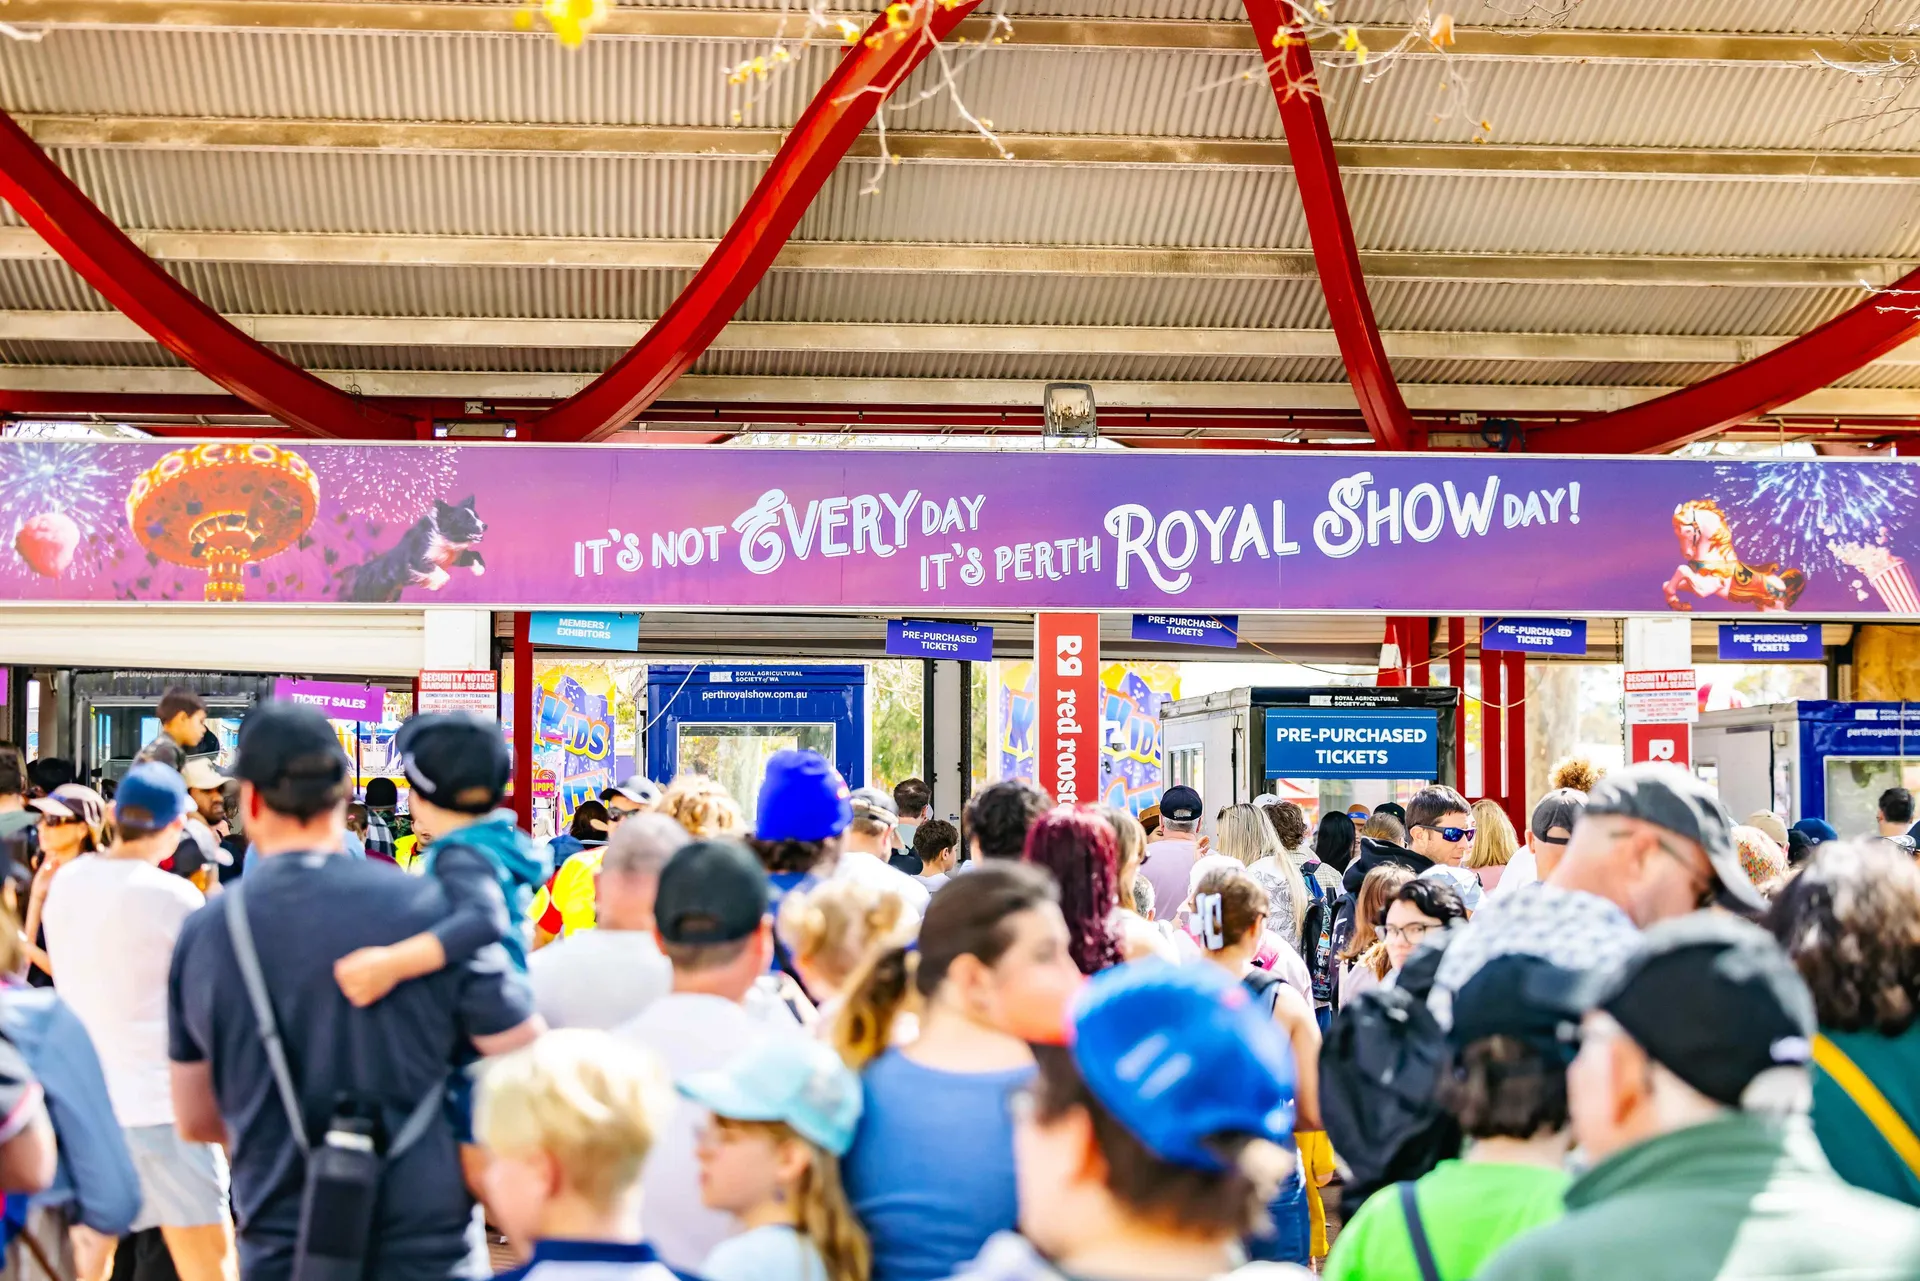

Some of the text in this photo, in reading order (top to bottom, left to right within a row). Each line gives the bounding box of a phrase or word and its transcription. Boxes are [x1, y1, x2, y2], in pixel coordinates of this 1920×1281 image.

[574, 488, 987, 578] IT'S NOT EVERY DAY
[920, 471, 1581, 595] IT'S PERTH ROYAL SHOW DAY!
[559, 618, 605, 629] MEMBERS
[1147, 615, 1222, 629] PRE-PURCHASED
[557, 627, 611, 640] EXHIBITORS
[902, 630, 978, 644] PRE-PURCHASED
[1166, 626, 1204, 637] TICKETS
[1497, 625, 1572, 637] PRE-PURCHASED
[1516, 635, 1554, 646] TICKETS
[1733, 634, 1808, 643] PRE-PURCHASED
[921, 641, 959, 652] TICKETS
[1751, 643, 1790, 652] TICKETS
[421, 673, 495, 682] SECURITY NOTICE
[421, 682, 495, 690] RANDOM BAG SEARCH
[292, 693, 367, 709] TICKET SALES
[702, 690, 808, 701] perthroyalshow.com.au
[1057, 689, 1082, 735] red
[1276, 727, 1428, 743] PRE-PURCHASED
[1315, 749, 1389, 765] TICKETS
[1056, 738, 1079, 806] roost
[532, 783, 555, 792] LIPOPS
